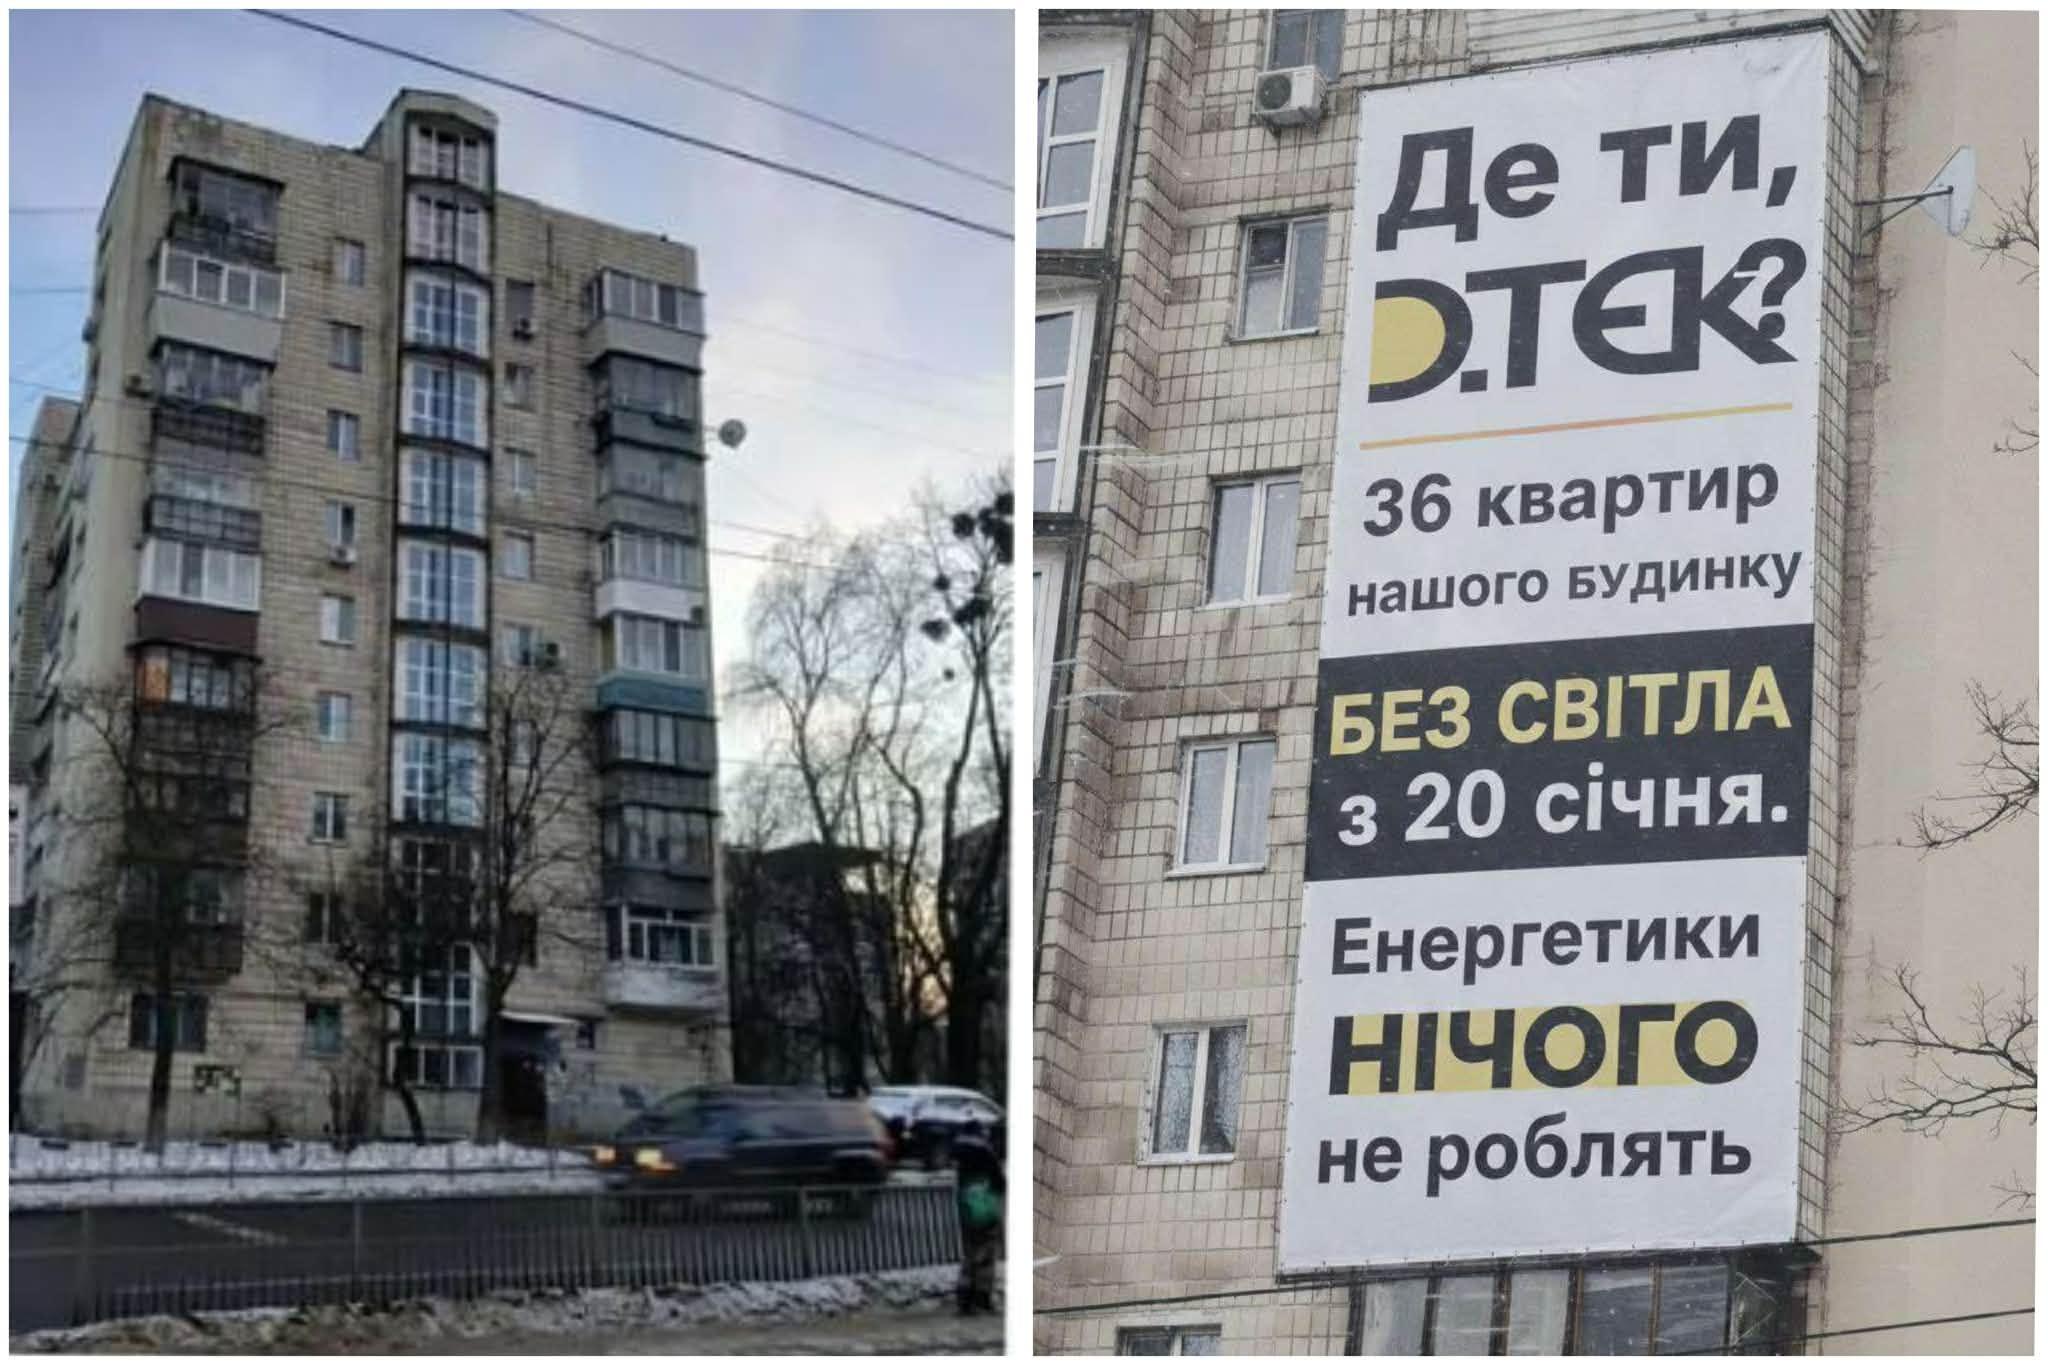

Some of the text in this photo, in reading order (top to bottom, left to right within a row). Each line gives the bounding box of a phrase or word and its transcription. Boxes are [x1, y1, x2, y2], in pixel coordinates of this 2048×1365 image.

[1376, 114, 1797, 252] Де ти,
[1363, 463, 1779, 537] 36 квартир
[1348, 572, 1548, 617] нашого
[1329, 665, 1792, 756] БЕЗ СВІТЛА
[1404, 768, 1506, 842] 20
[1535, 760, 1788, 834] січня.
[1331, 913, 1759, 986] Енергетики
[1329, 1000, 1759, 1096] НІЧОГО
[1317, 1111, 1752, 1198] не роблять
